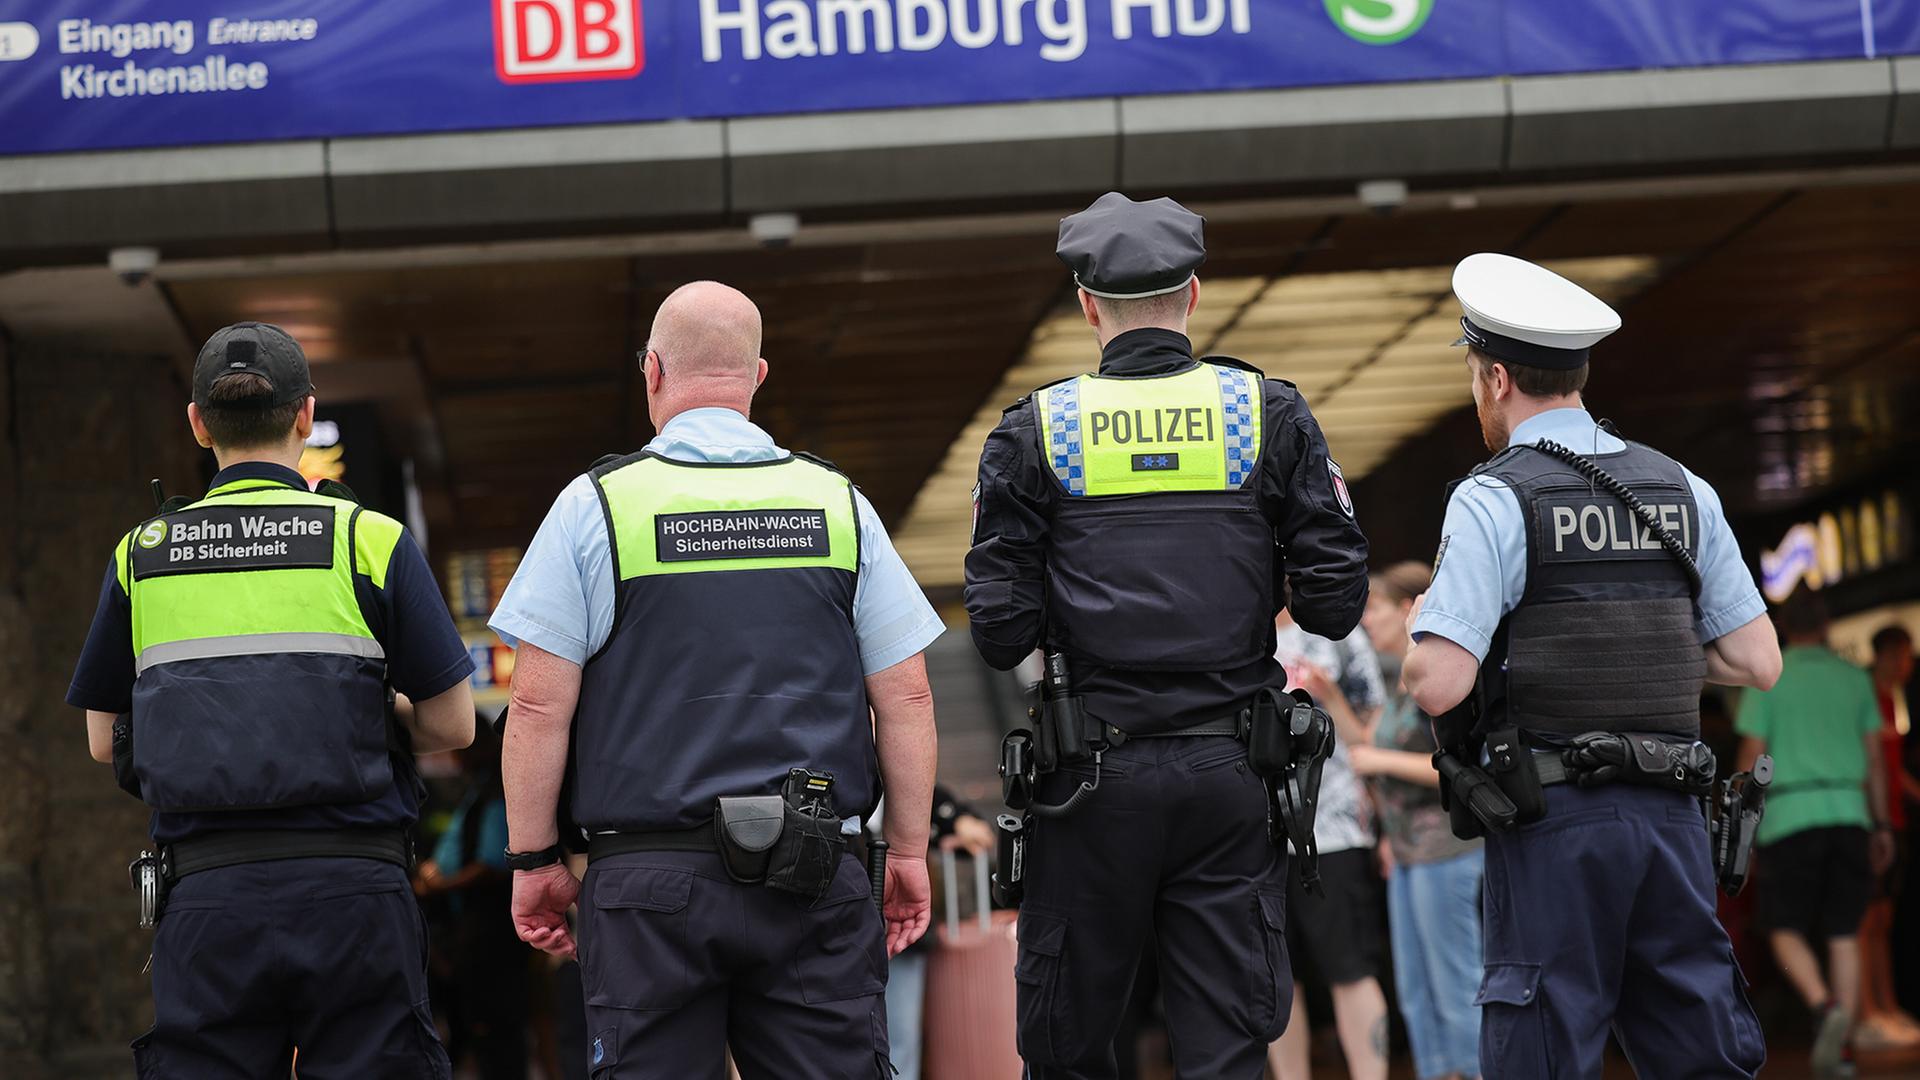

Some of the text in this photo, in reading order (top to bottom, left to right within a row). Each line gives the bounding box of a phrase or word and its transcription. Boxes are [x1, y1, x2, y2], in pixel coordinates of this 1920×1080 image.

[58, 17, 318, 58] Eingang Entrance
[514, 0, 621, 62] DB
[700, 0, 1088, 63] Hamburg
[61, 54, 268, 100] Kirchenallee
[1091, 408, 1214, 446] POLIZEI
[142, 515, 324, 546] S Bahn Wache
[663, 516, 822, 535] HOCHBAHN-WACHE
[675, 534, 813, 553] Sicherheitsdienst
[1552, 504, 1691, 552] POLIZEI
[169, 540, 288, 562] DB Sicherheit
